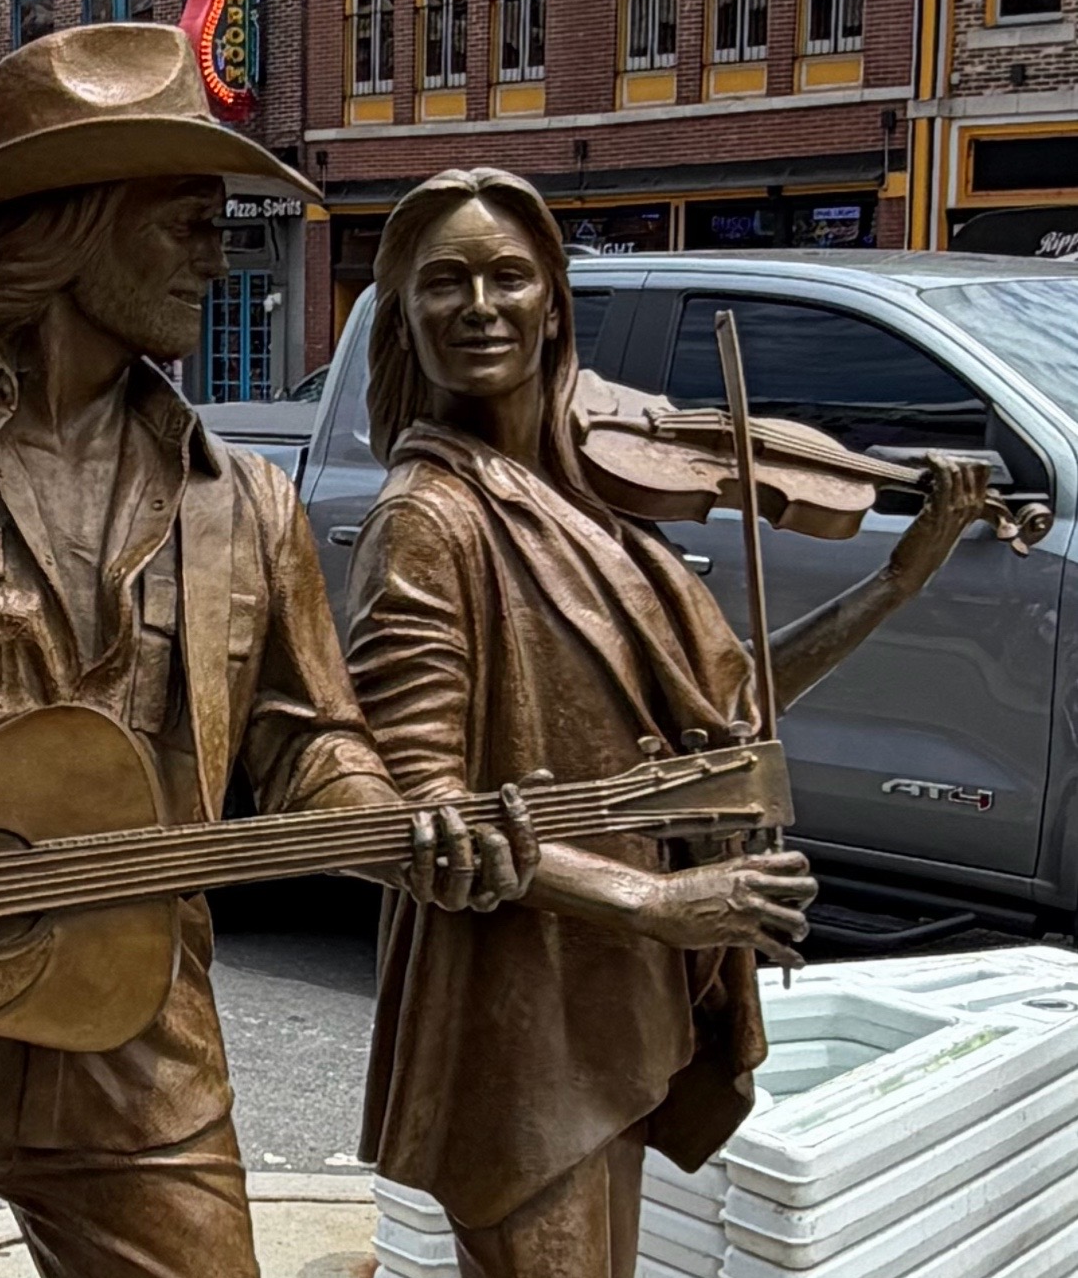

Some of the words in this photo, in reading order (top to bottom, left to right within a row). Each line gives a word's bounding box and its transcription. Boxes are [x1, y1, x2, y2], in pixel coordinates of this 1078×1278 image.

[225, 199, 257, 218] Pizza
[263, 197, 301, 217] Spirits
[881, 777, 993, 812] AT4
